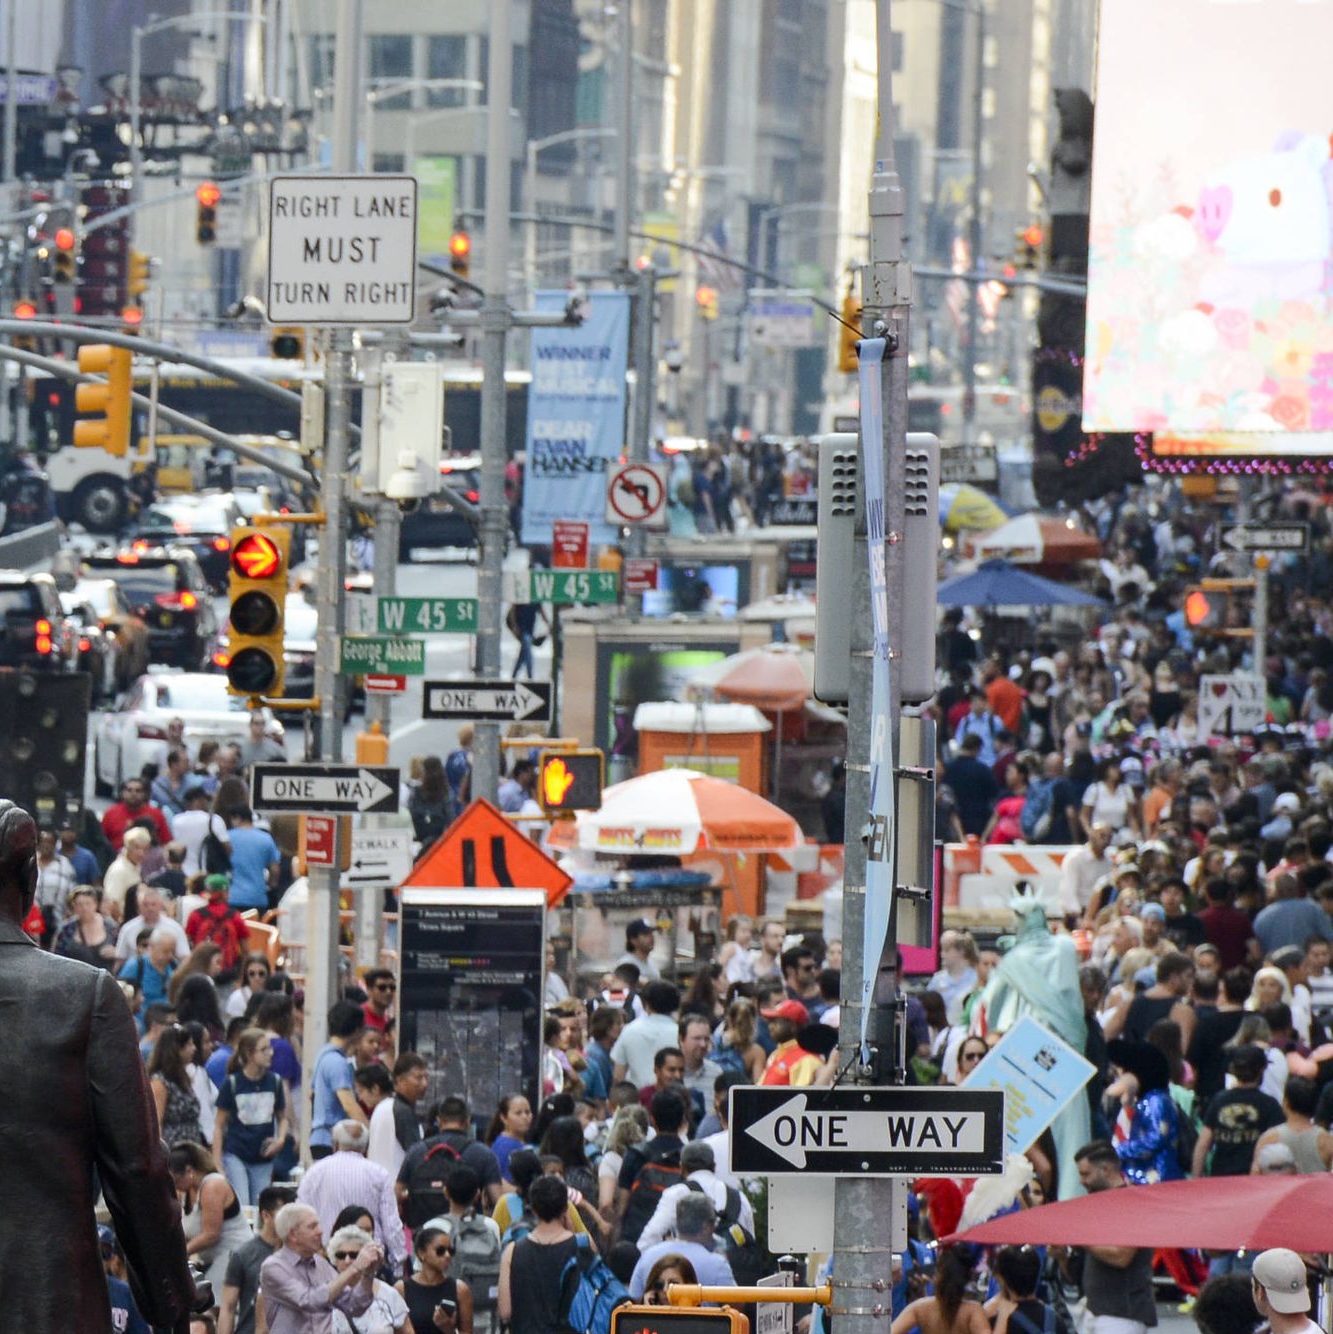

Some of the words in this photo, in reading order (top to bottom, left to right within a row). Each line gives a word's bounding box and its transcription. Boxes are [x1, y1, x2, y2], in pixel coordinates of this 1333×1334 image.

[275, 196, 341, 219] RIGHT
[353, 196, 411, 220] LANE
[302, 237, 382, 265] MUST
[271, 282, 331, 306] TURN
[343, 282, 410, 306] RIGHT
[536, 345, 611, 361] WINNER
[532, 438, 586, 456] EVAN
[532, 455, 613, 473] HANSE
[533, 573, 555, 599] W
[564, 573, 590, 599] 45
[598, 573, 614, 592] St
[381, 601, 406, 629] W
[415, 601, 445, 630] 45
[456, 602, 473, 621] St
[341, 640, 382, 663] George
[384, 641, 422, 662] Abbott
[440, 693, 476, 708] ONE
[494, 693, 531, 711] WAY
[273, 779, 314, 798] ONE
[334, 780, 375, 800] WAY
[773, 1115, 849, 1149] ONE
[887, 1116, 968, 1150] WAY
